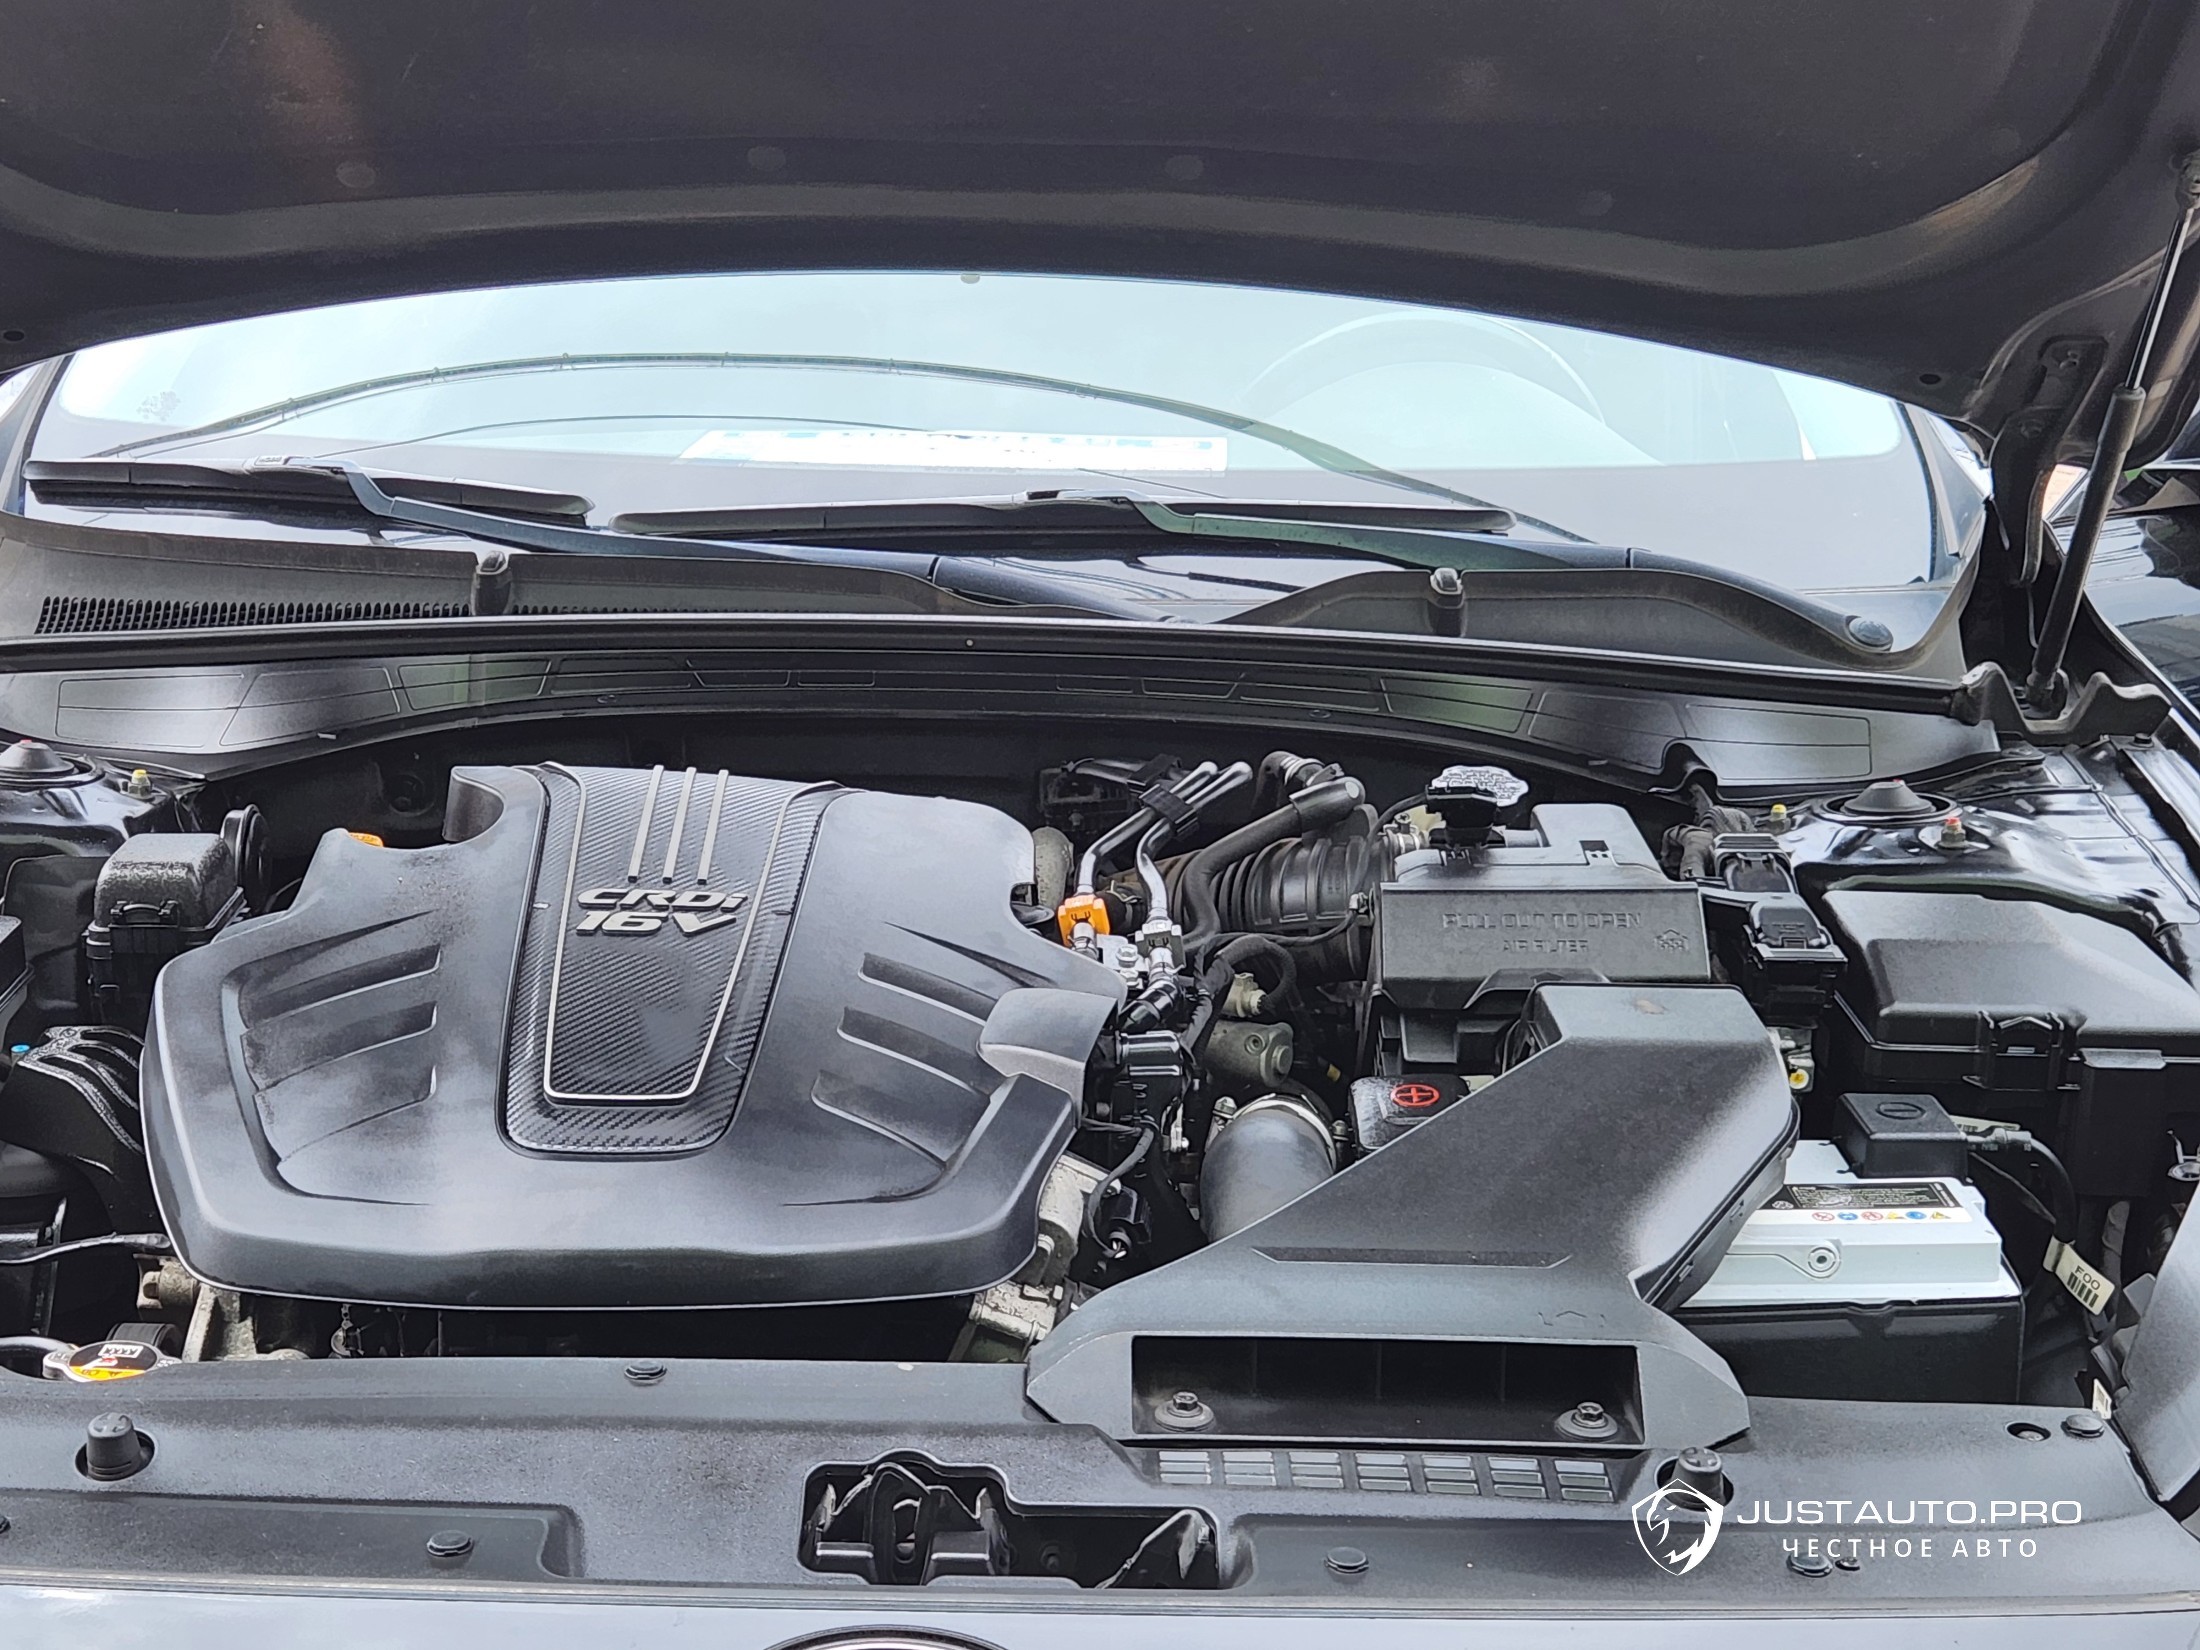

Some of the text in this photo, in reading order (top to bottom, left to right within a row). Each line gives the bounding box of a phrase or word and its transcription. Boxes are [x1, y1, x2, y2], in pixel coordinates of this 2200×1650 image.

[1442, 912, 1642, 929] PULL OUT TO OPEN
